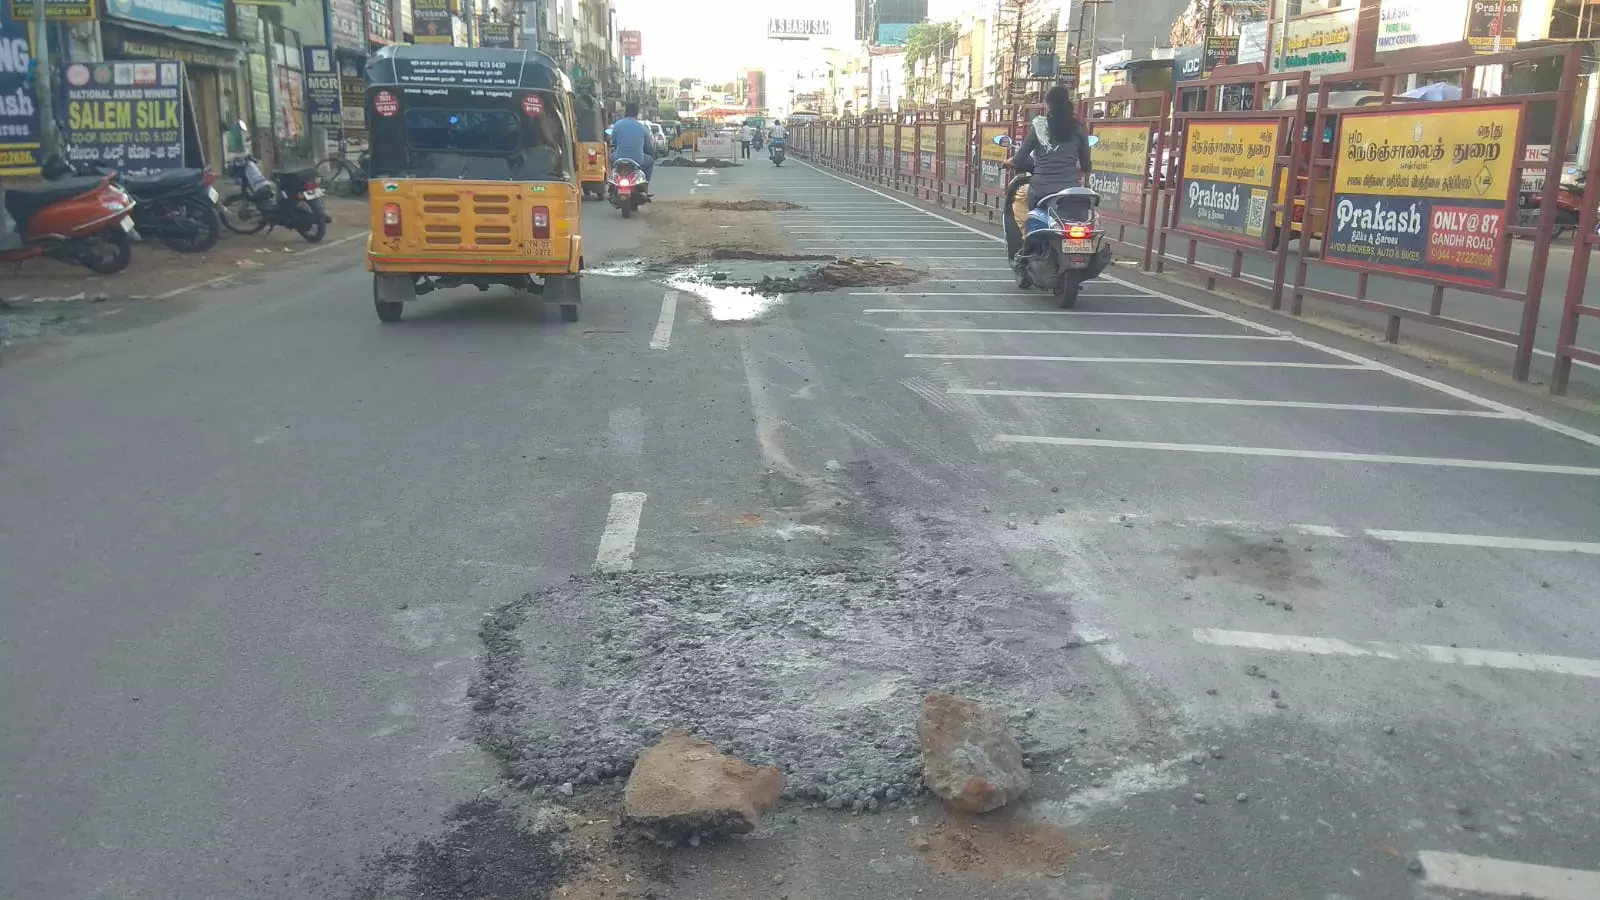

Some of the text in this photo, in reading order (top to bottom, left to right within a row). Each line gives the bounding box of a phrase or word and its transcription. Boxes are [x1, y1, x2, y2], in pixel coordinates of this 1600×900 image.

[1474, 2, 1518, 13] Praksh
[69, 88, 177, 99] NATIONAL AWARD WINNER
[308, 78, 339, 89] MGR
[69, 100, 179, 129] SALEM SILK
[1348, 137, 1501, 163] நெடுஞ்சாலைத் துறை
[1089, 174, 1120, 194] Prakash
[1189, 181, 1240, 212] Prakash
[1337, 199, 1421, 234] Prakash
[1351, 230, 1367, 242] Silks
[1375, 233, 1398, 245] Sarees
[1432, 231, 1496, 253] GANDHI ROAD,
[1330, 242, 1346, 252] AVOID
[1376, 247, 1394, 258] AUTO
[1400, 250, 1420, 262] BIKES
